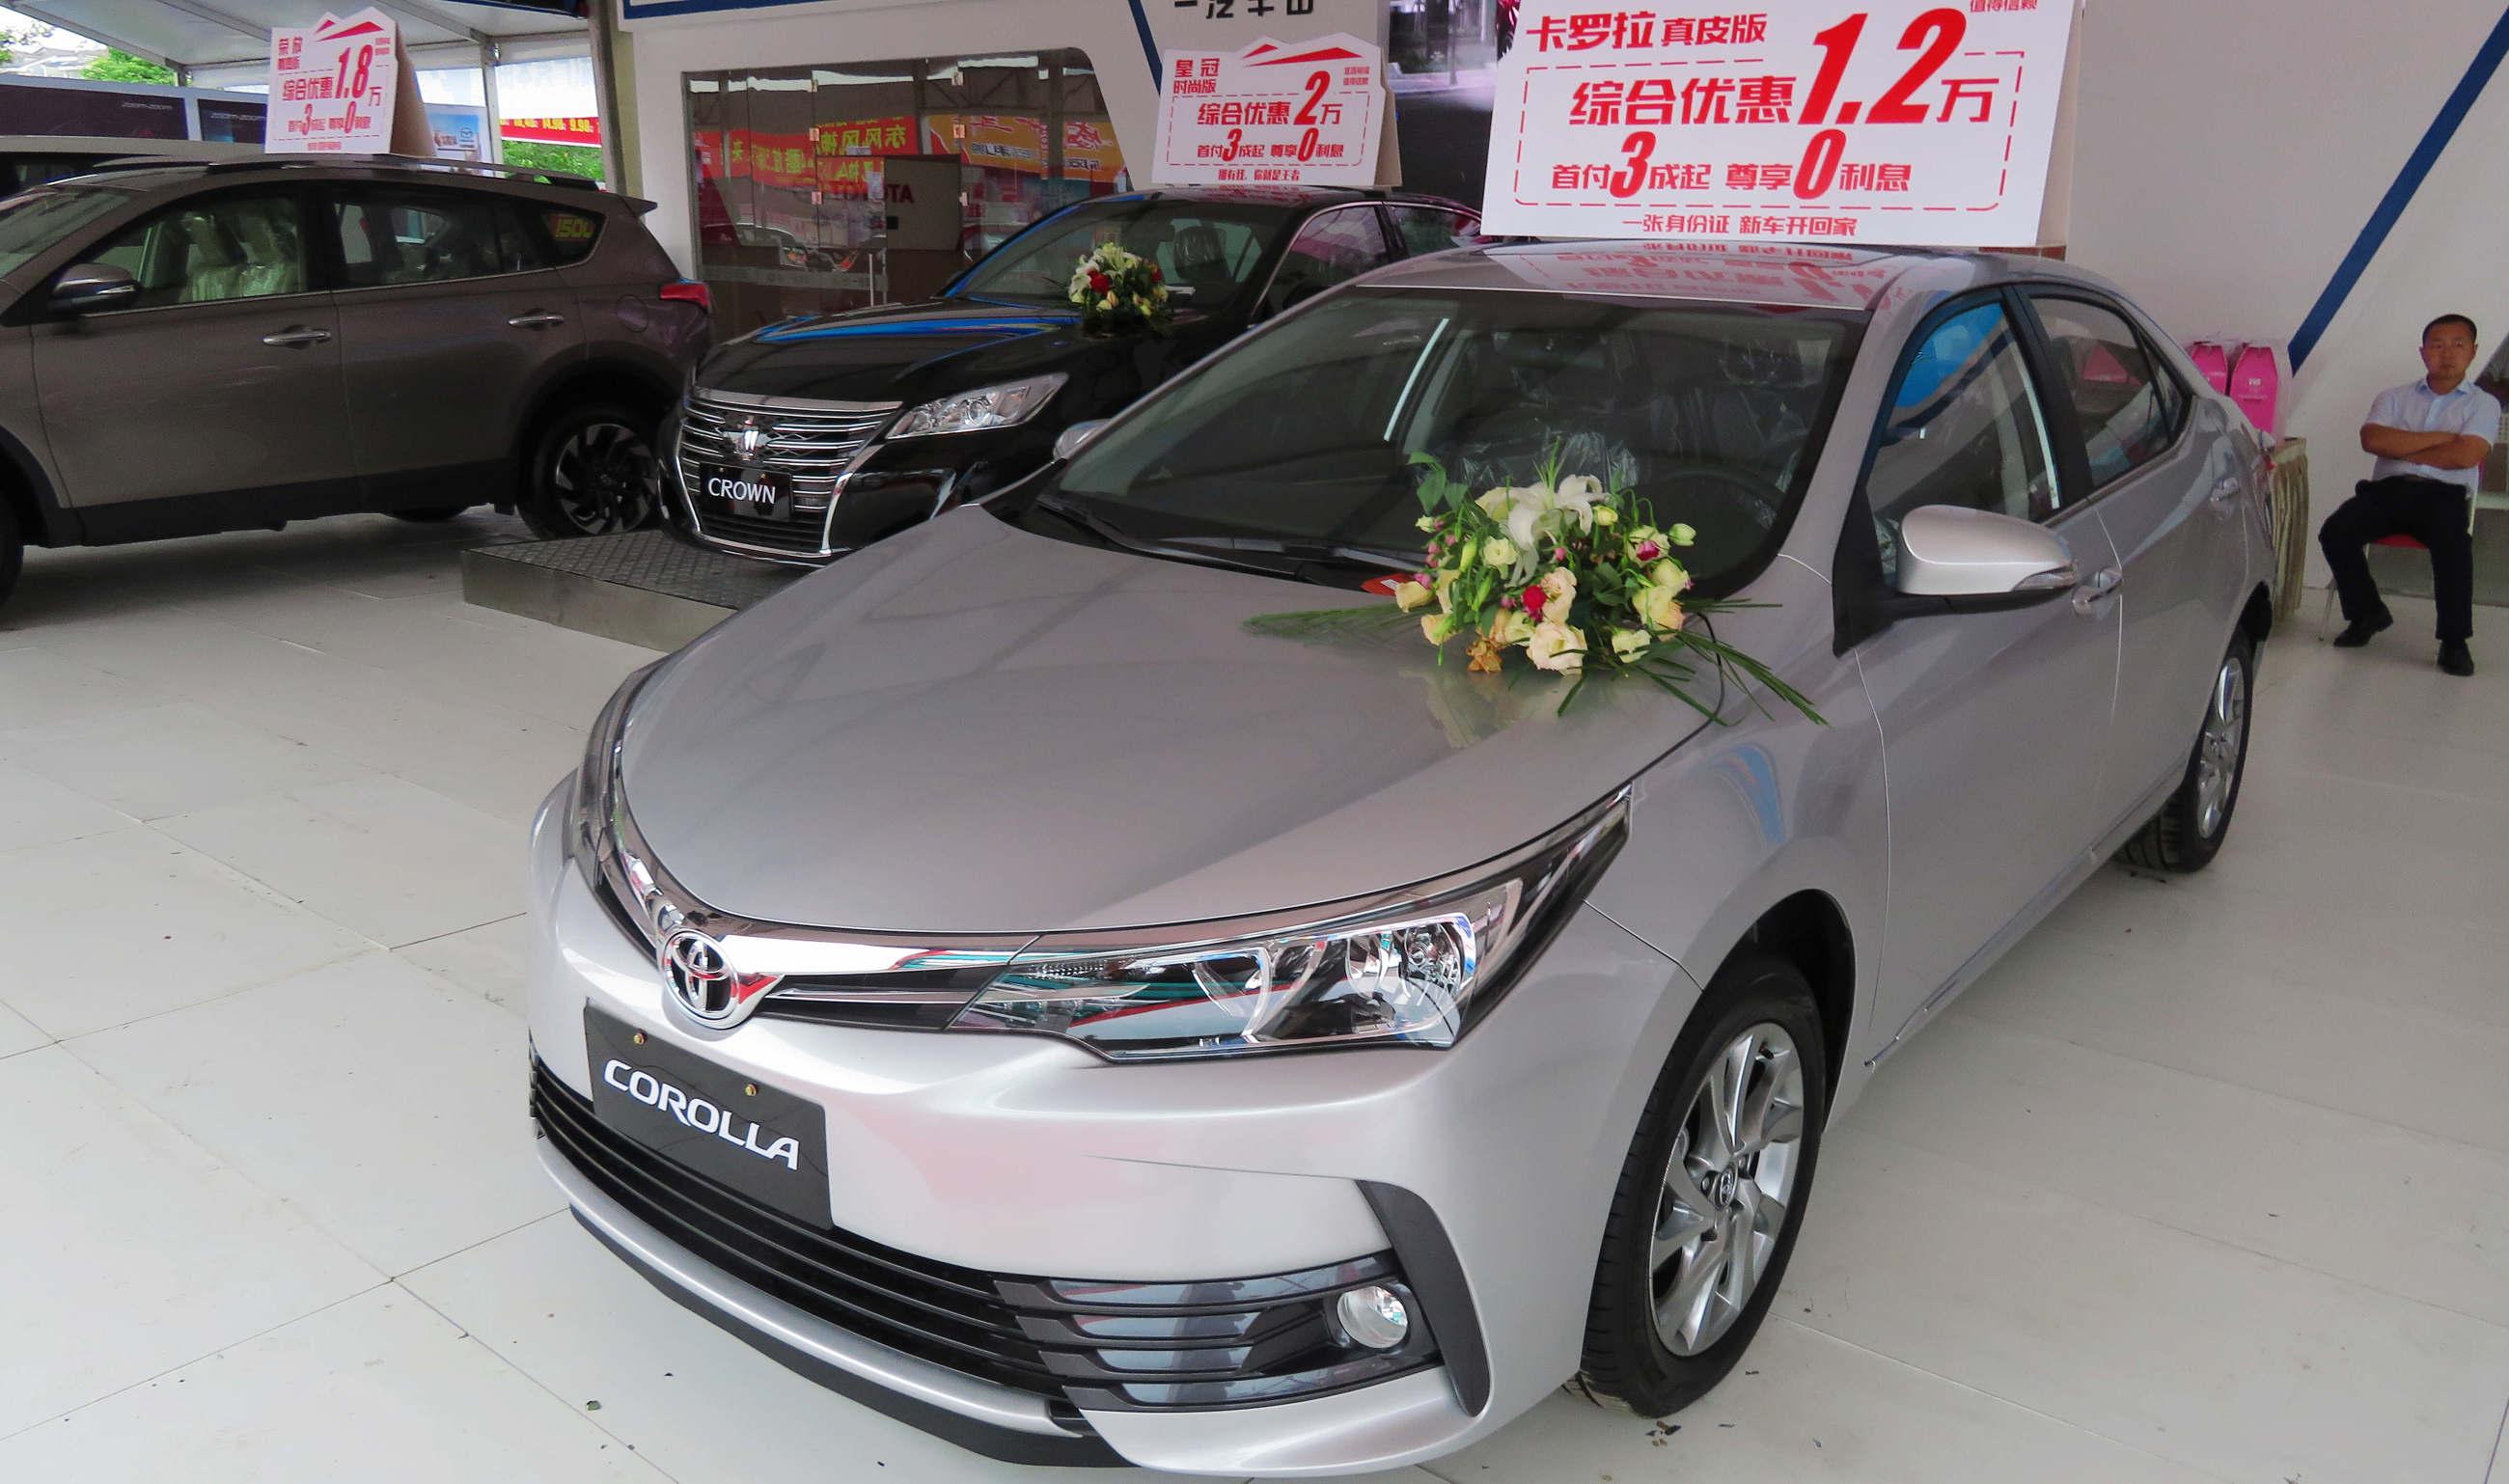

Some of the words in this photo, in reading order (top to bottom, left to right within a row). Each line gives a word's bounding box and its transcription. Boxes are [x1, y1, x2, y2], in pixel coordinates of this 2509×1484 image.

[1526, 12, 1657, 52] 卡罗拉
[1661, 13, 1767, 44] 真皮版
[1174, 58, 1220, 78] 皇冠
[1173, 80, 1216, 94] 时尚版
[1197, 128, 1265, 162] 首付3成起
[1270, 127, 1343, 162] 尊享0利息
[1551, 130, 1711, 199] 首付3成起
[1725, 128, 1912, 201] 尊享0利息
[1623, 214, 1730, 235] 一张身份证
[1739, 215, 1859, 236] 新车开回家
[707, 477, 776, 505] CROWN
[603, 1058, 801, 1171] COROLLA
